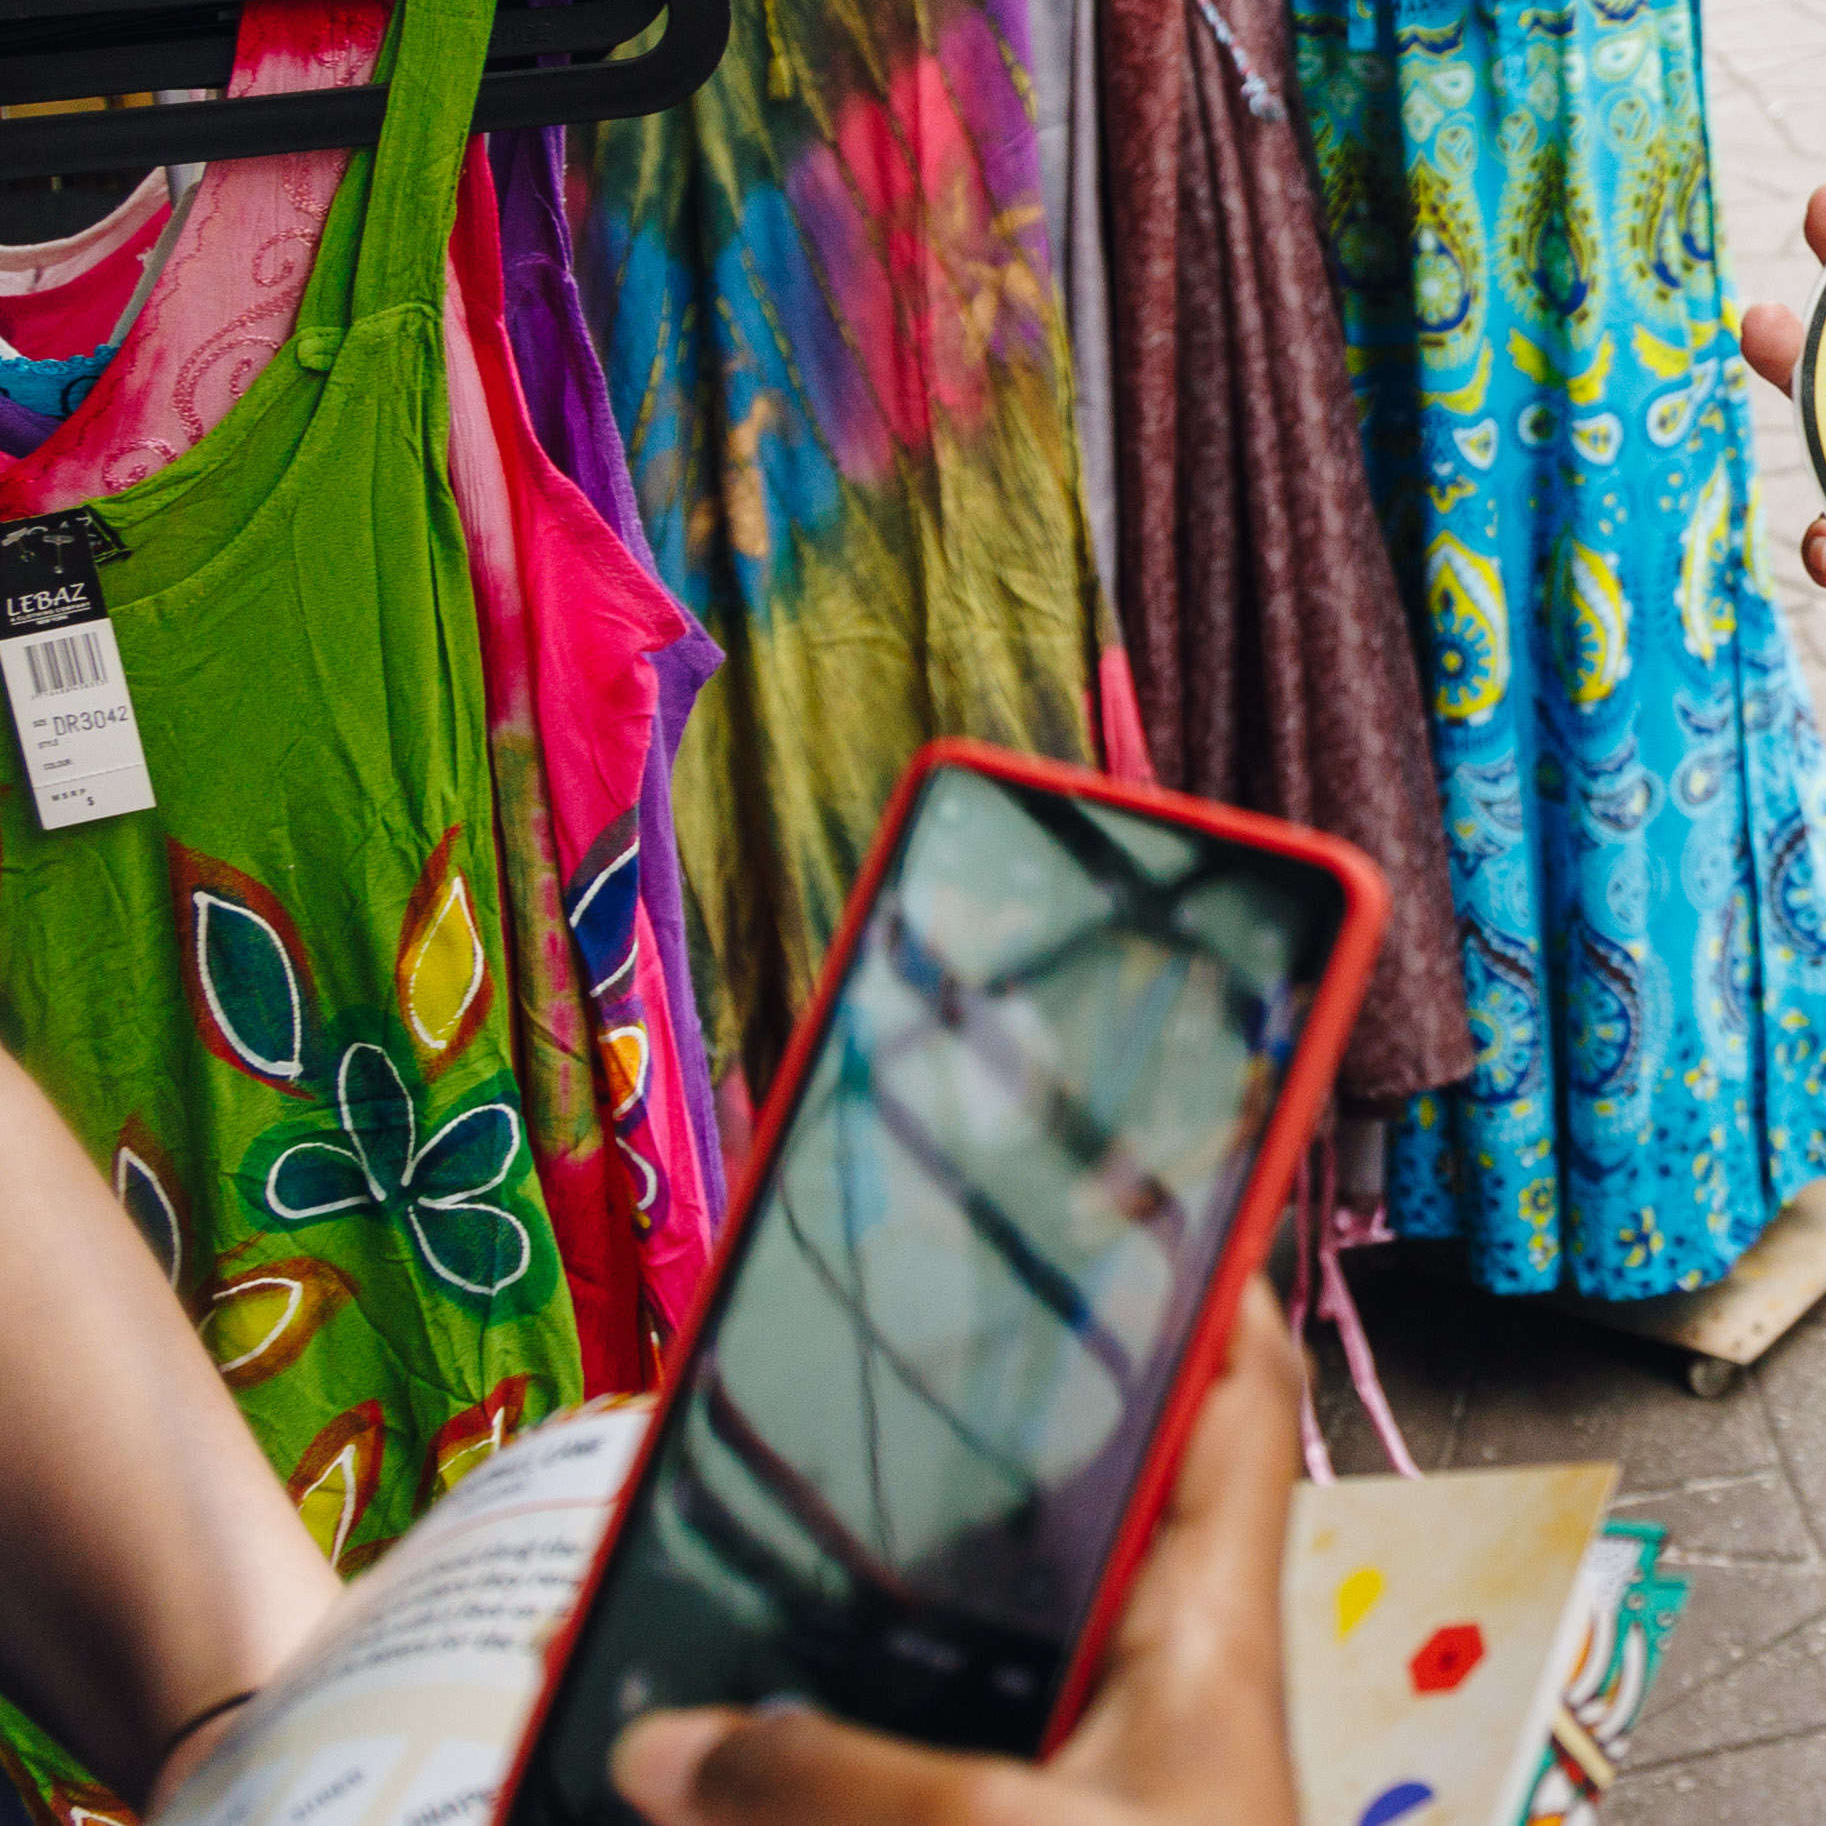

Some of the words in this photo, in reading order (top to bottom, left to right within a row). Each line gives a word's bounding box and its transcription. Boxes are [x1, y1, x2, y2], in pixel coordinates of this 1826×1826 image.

[6, 582, 88, 617] LEBAZ
[52, 705, 129, 737] DR3042
[87, 796, 95, 806] S
